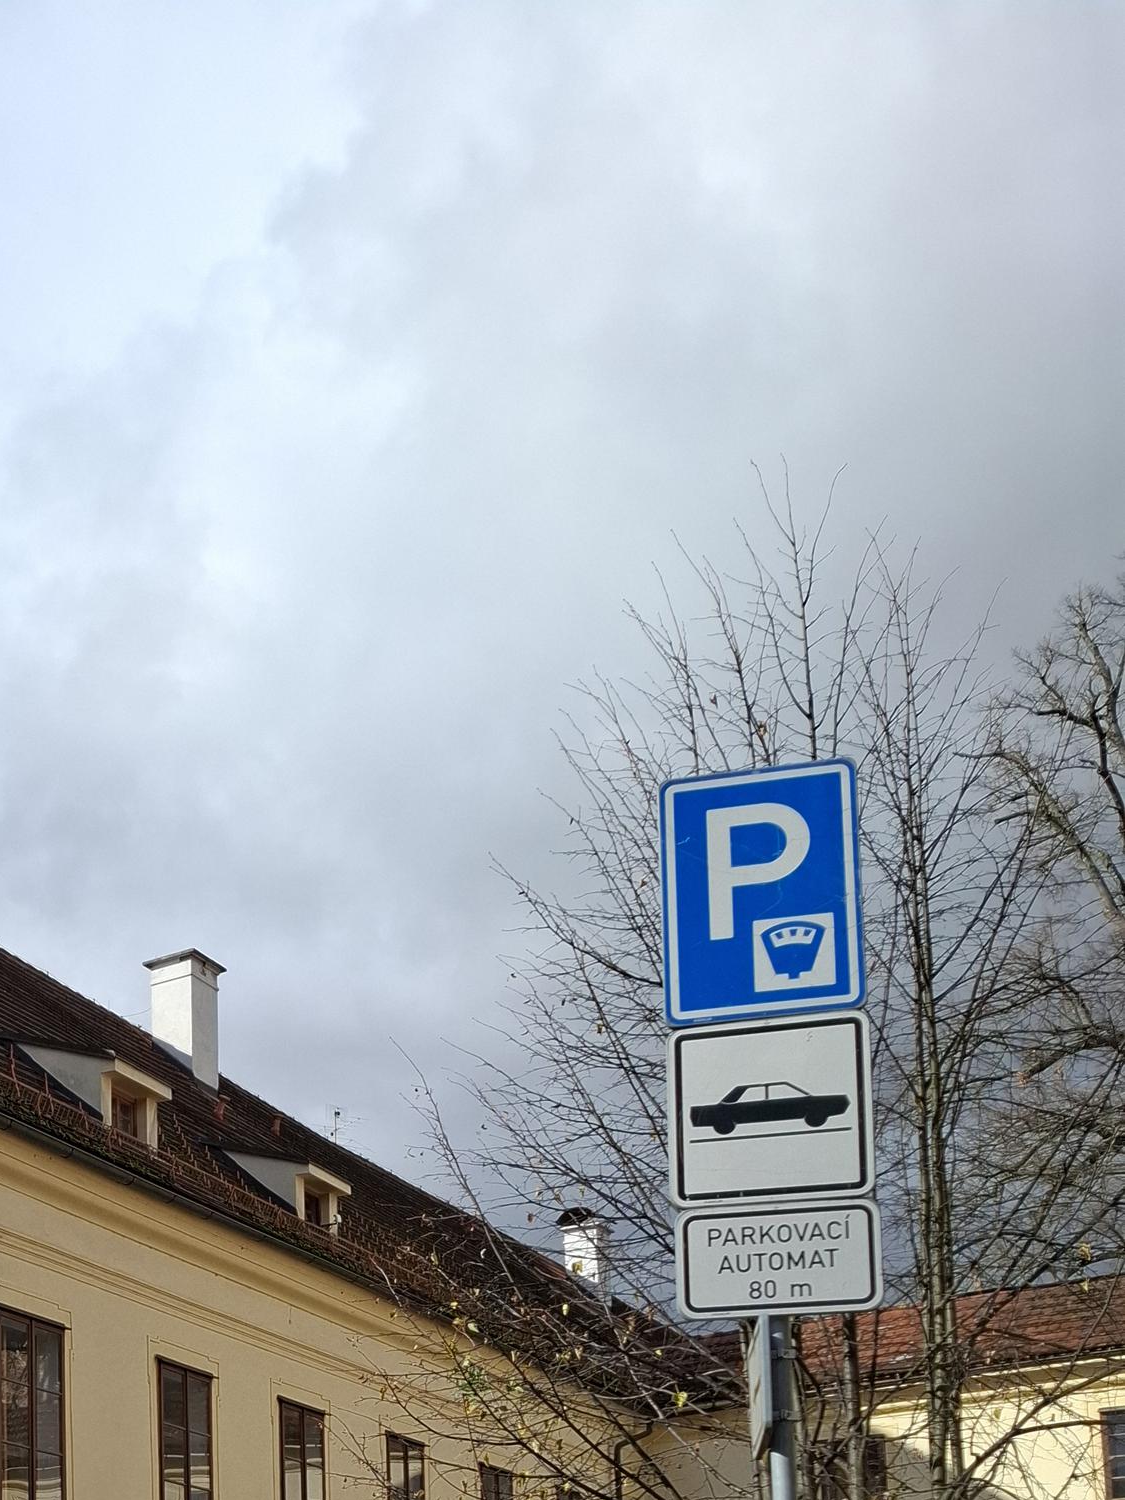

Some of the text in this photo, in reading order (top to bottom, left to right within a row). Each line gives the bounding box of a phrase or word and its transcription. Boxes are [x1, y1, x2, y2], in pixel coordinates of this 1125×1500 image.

[706, 802, 811, 941] P
[706, 1213, 851, 1248] PARKOVACÍ
[717, 1247, 840, 1275] AUTOMAT
[748, 1279, 813, 1300] 80 m
